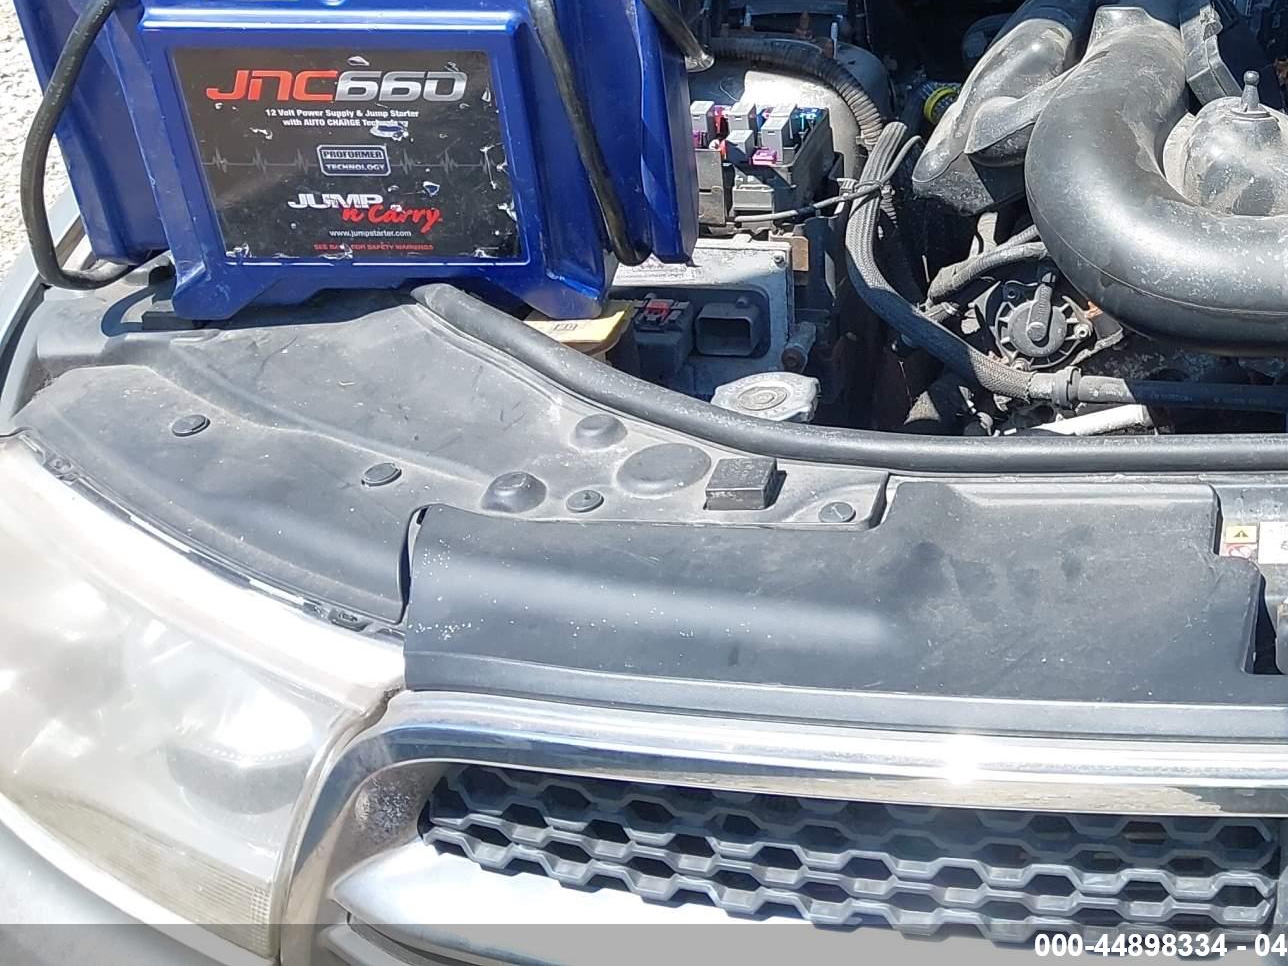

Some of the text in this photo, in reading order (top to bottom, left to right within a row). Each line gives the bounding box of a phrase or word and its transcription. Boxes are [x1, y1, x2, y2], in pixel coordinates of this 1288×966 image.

[206, 70, 468, 101] JNC660
[265, 109, 420, 119] 12 Volt Power Supply & Jump Starter
[282, 118, 303, 126] with
[321, 150, 384, 160] PROFORMER
[325, 163, 386, 171] TECHNOLOGY
[287, 193, 384, 209] JUMP
[367, 202, 441, 234] Carry
[328, 230, 412, 238] www.jumpstarter.com
